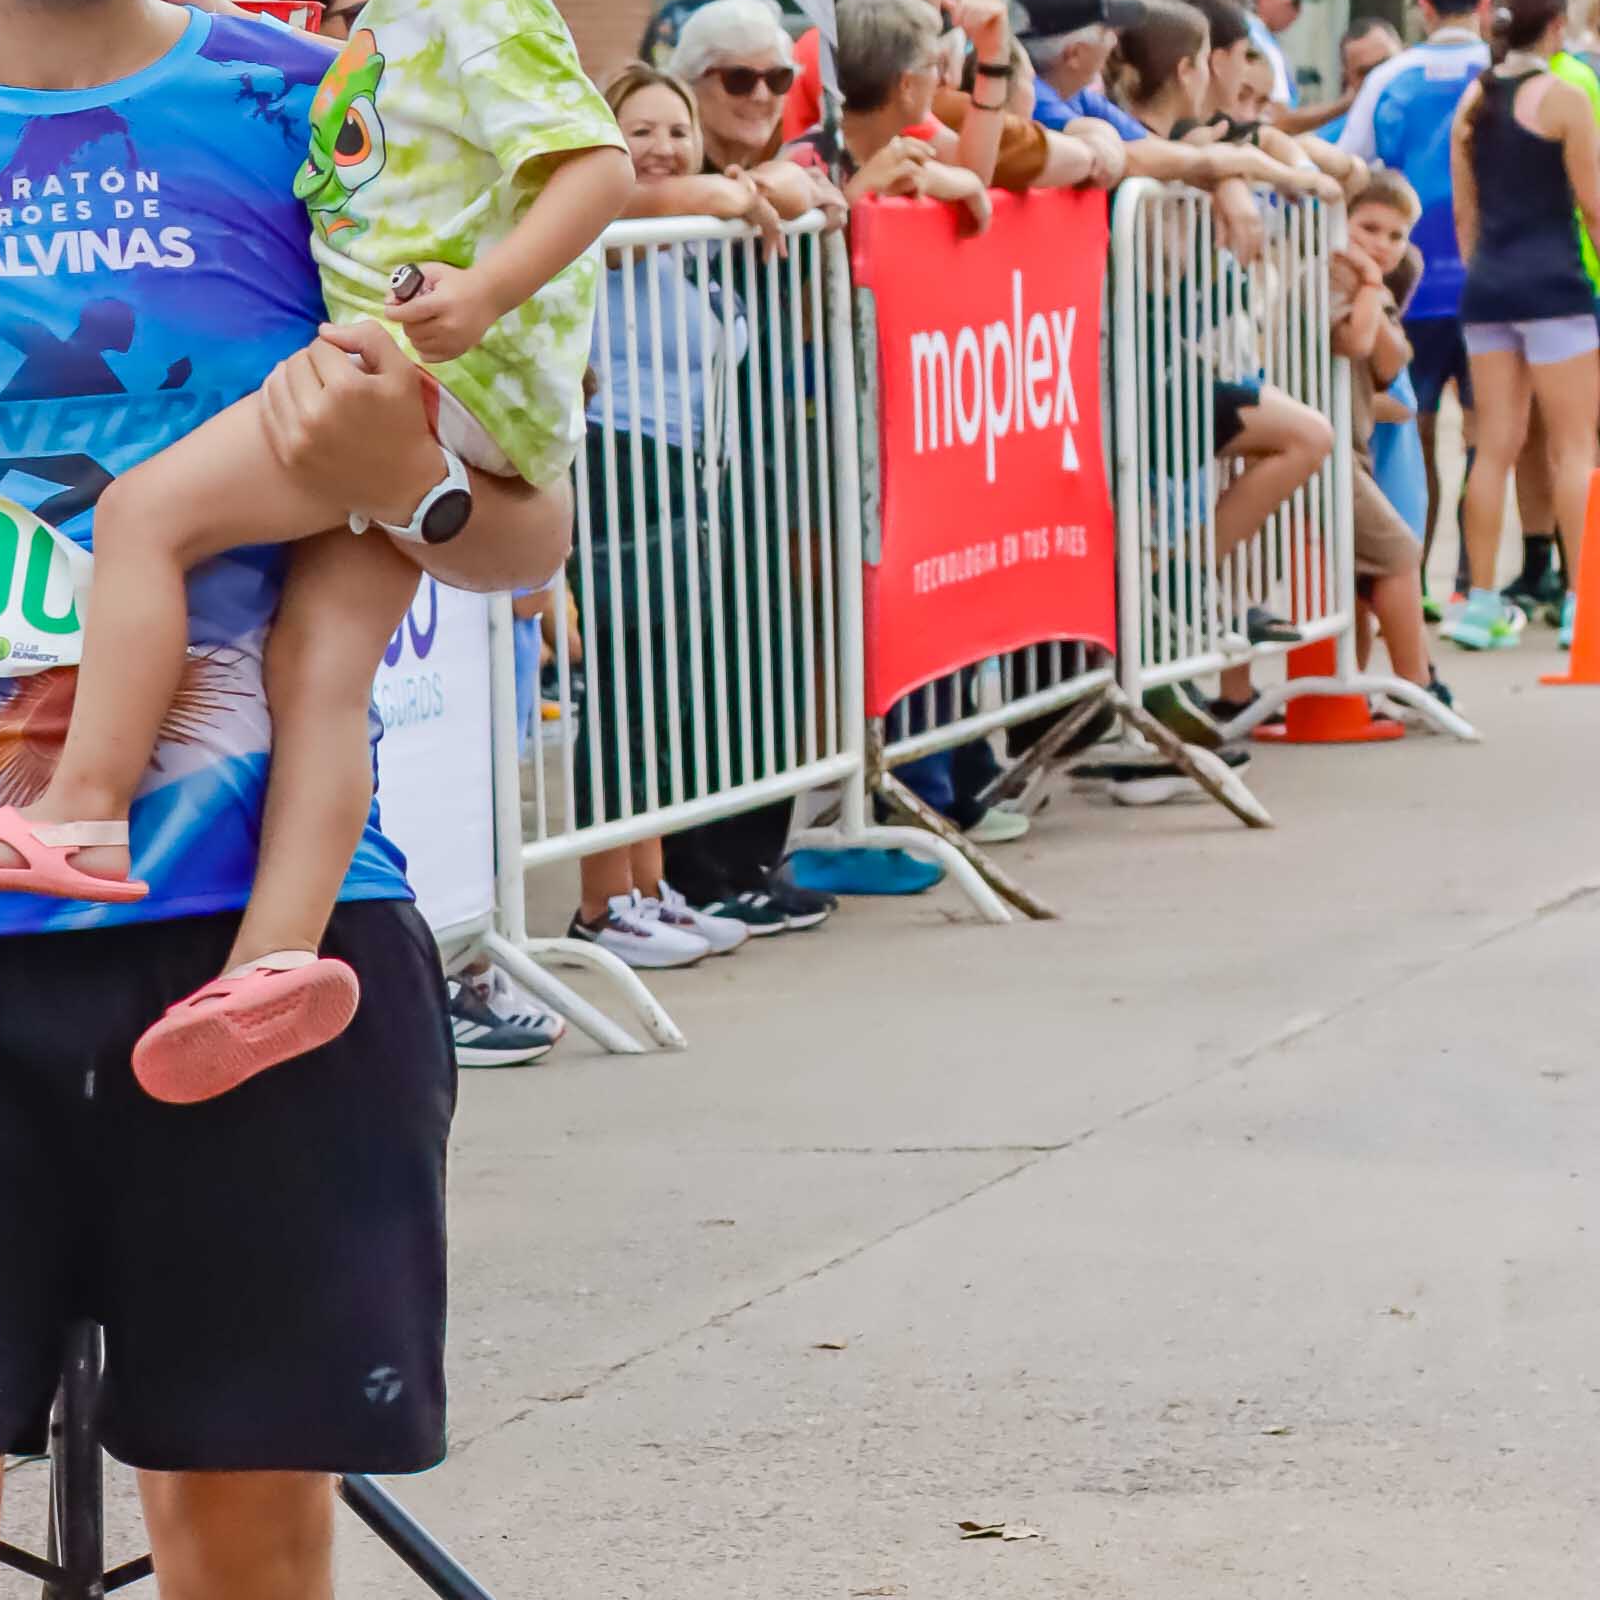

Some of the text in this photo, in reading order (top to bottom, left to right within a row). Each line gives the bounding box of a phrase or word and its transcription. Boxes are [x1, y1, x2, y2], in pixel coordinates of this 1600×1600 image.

[115, 199, 161, 220] DE
[910, 269, 1080, 483] moplex
[1022, 527, 1049, 560] TUS
[1055, 524, 1088, 559] PIES
[374, 670, 445, 730] GUROS
